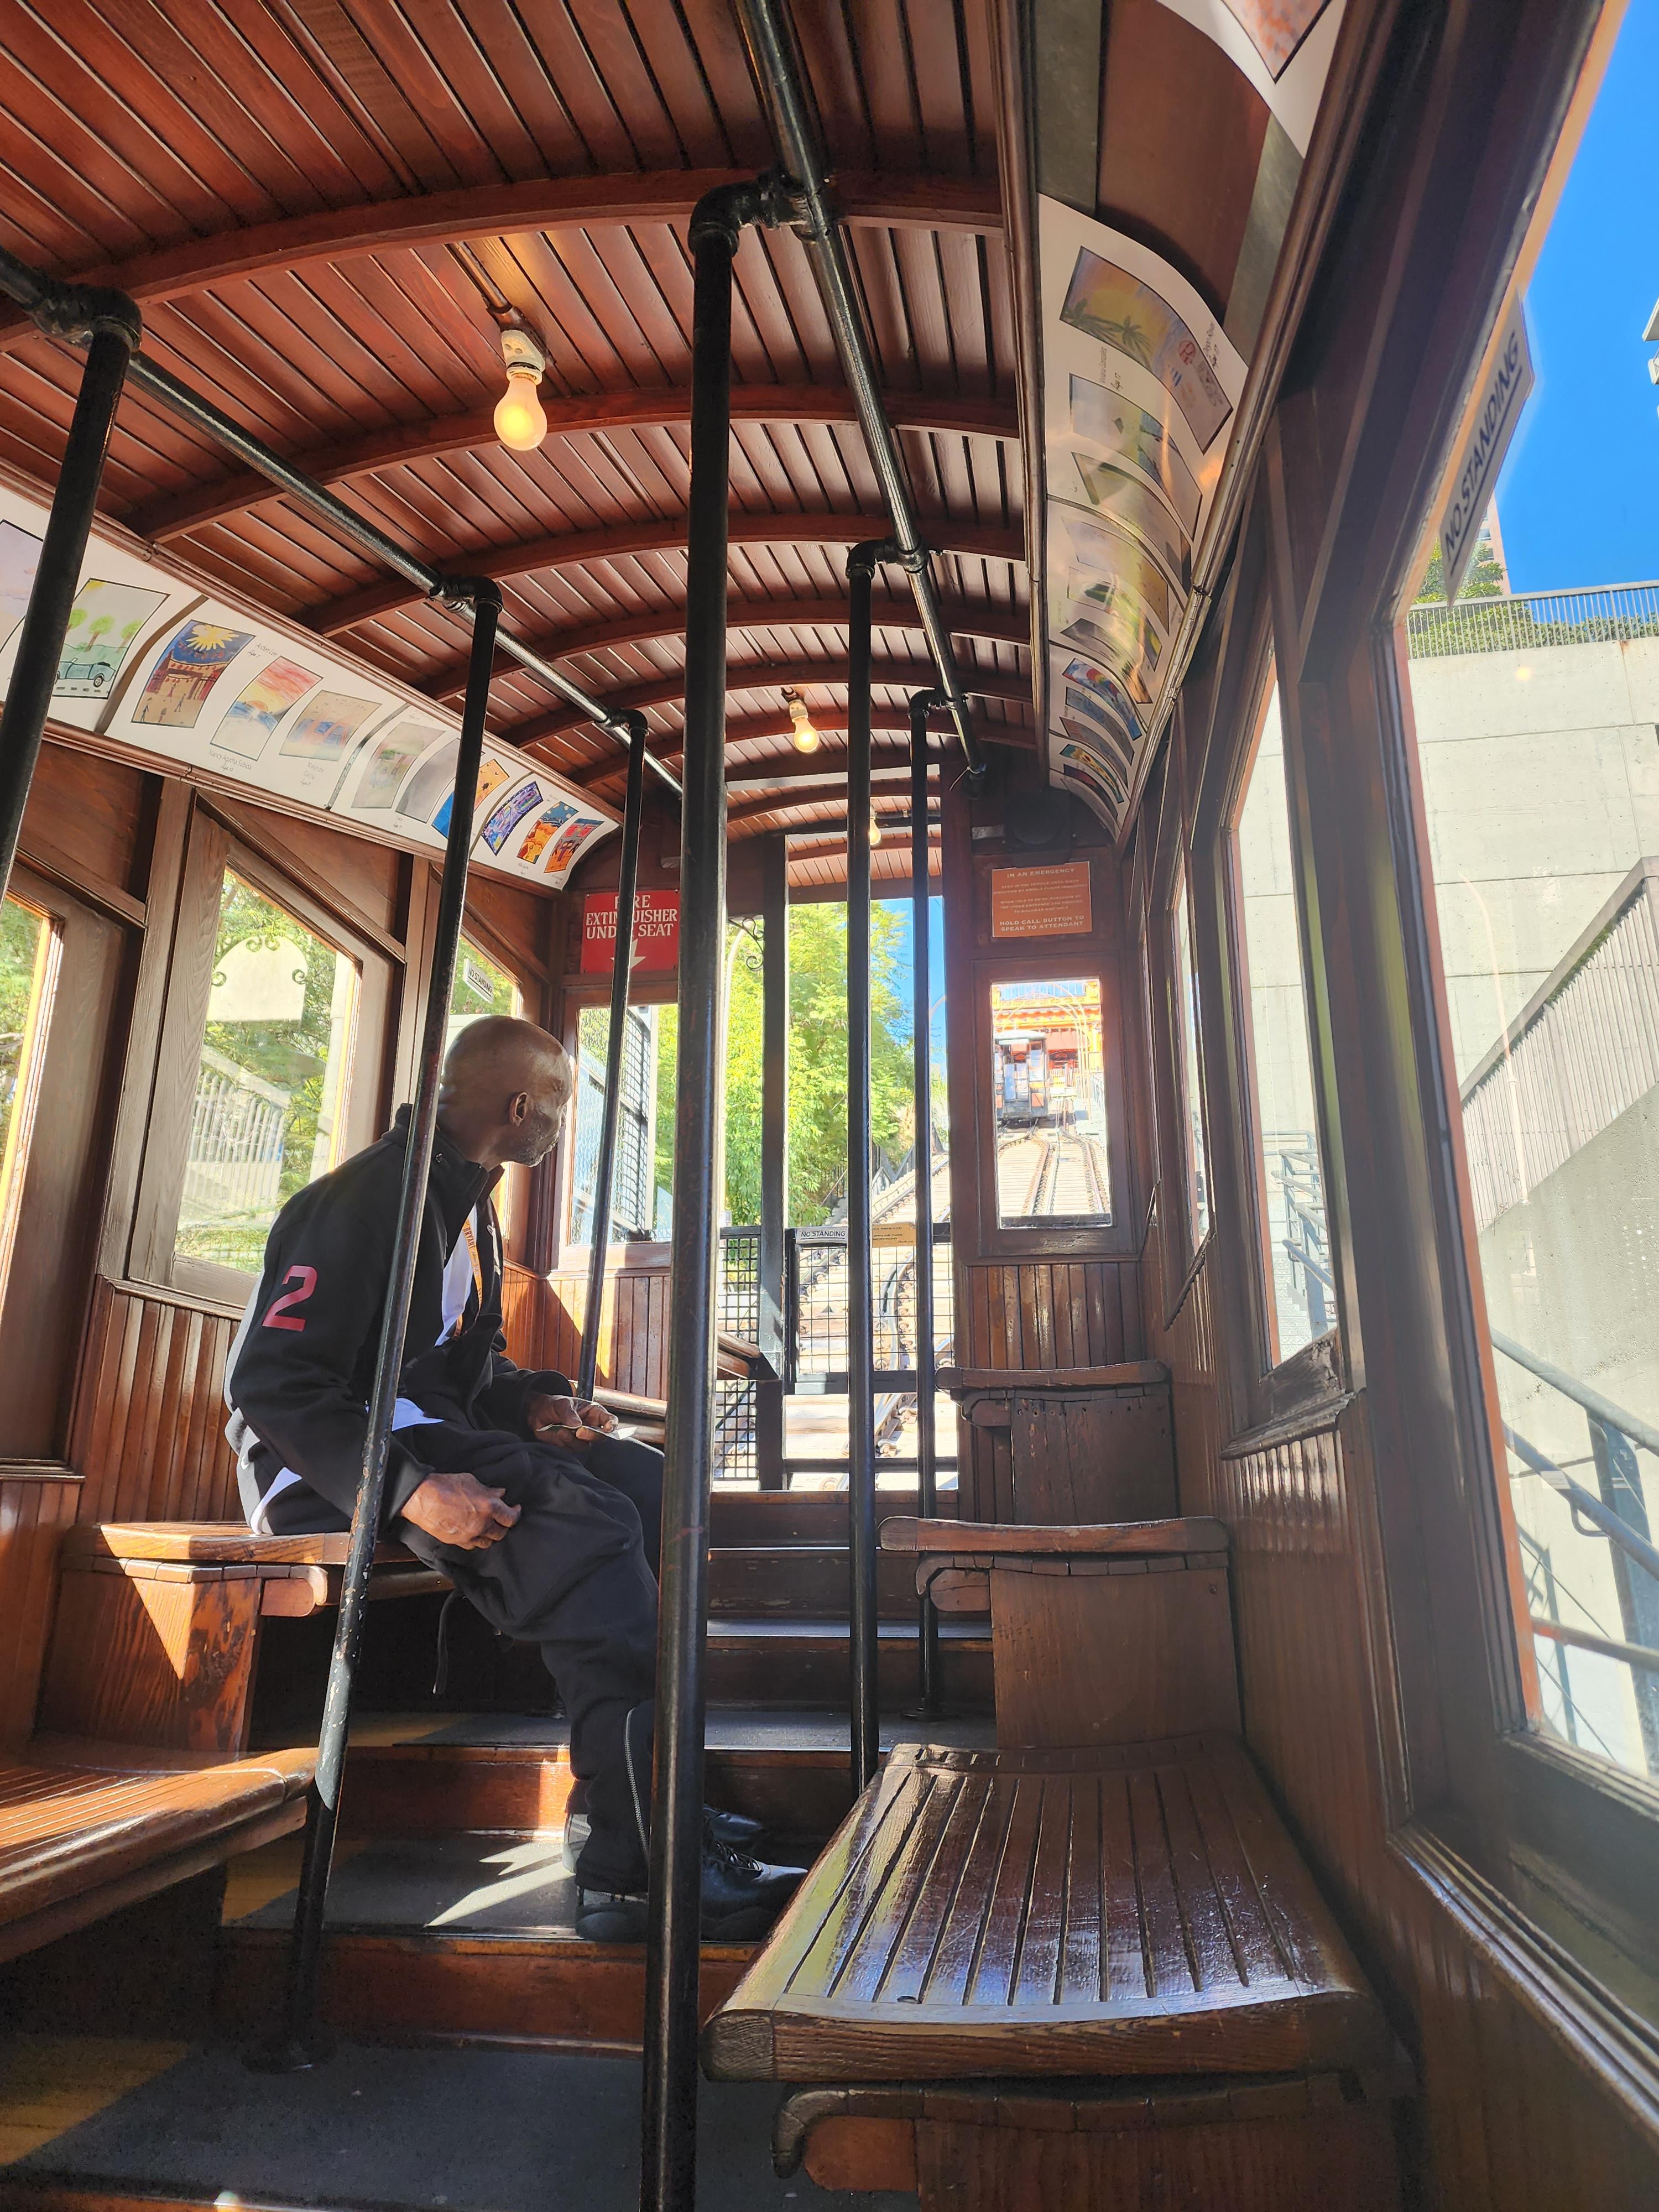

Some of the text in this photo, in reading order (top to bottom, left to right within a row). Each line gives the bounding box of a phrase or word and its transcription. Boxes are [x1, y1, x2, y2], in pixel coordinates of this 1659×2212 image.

[1444, 330, 1519, 562] NO STANDING
[1030, 868, 1075, 877] EMERGENCY
[614, 895, 651, 910] FRE
[586, 923, 674, 939] UND SEAT
[1039, 921, 1084, 930] ATTENDANT
[468, 967, 492, 993] NO STANDING
[463, 1227, 476, 1249] BRYANT
[262, 1265, 318, 1332] 2
